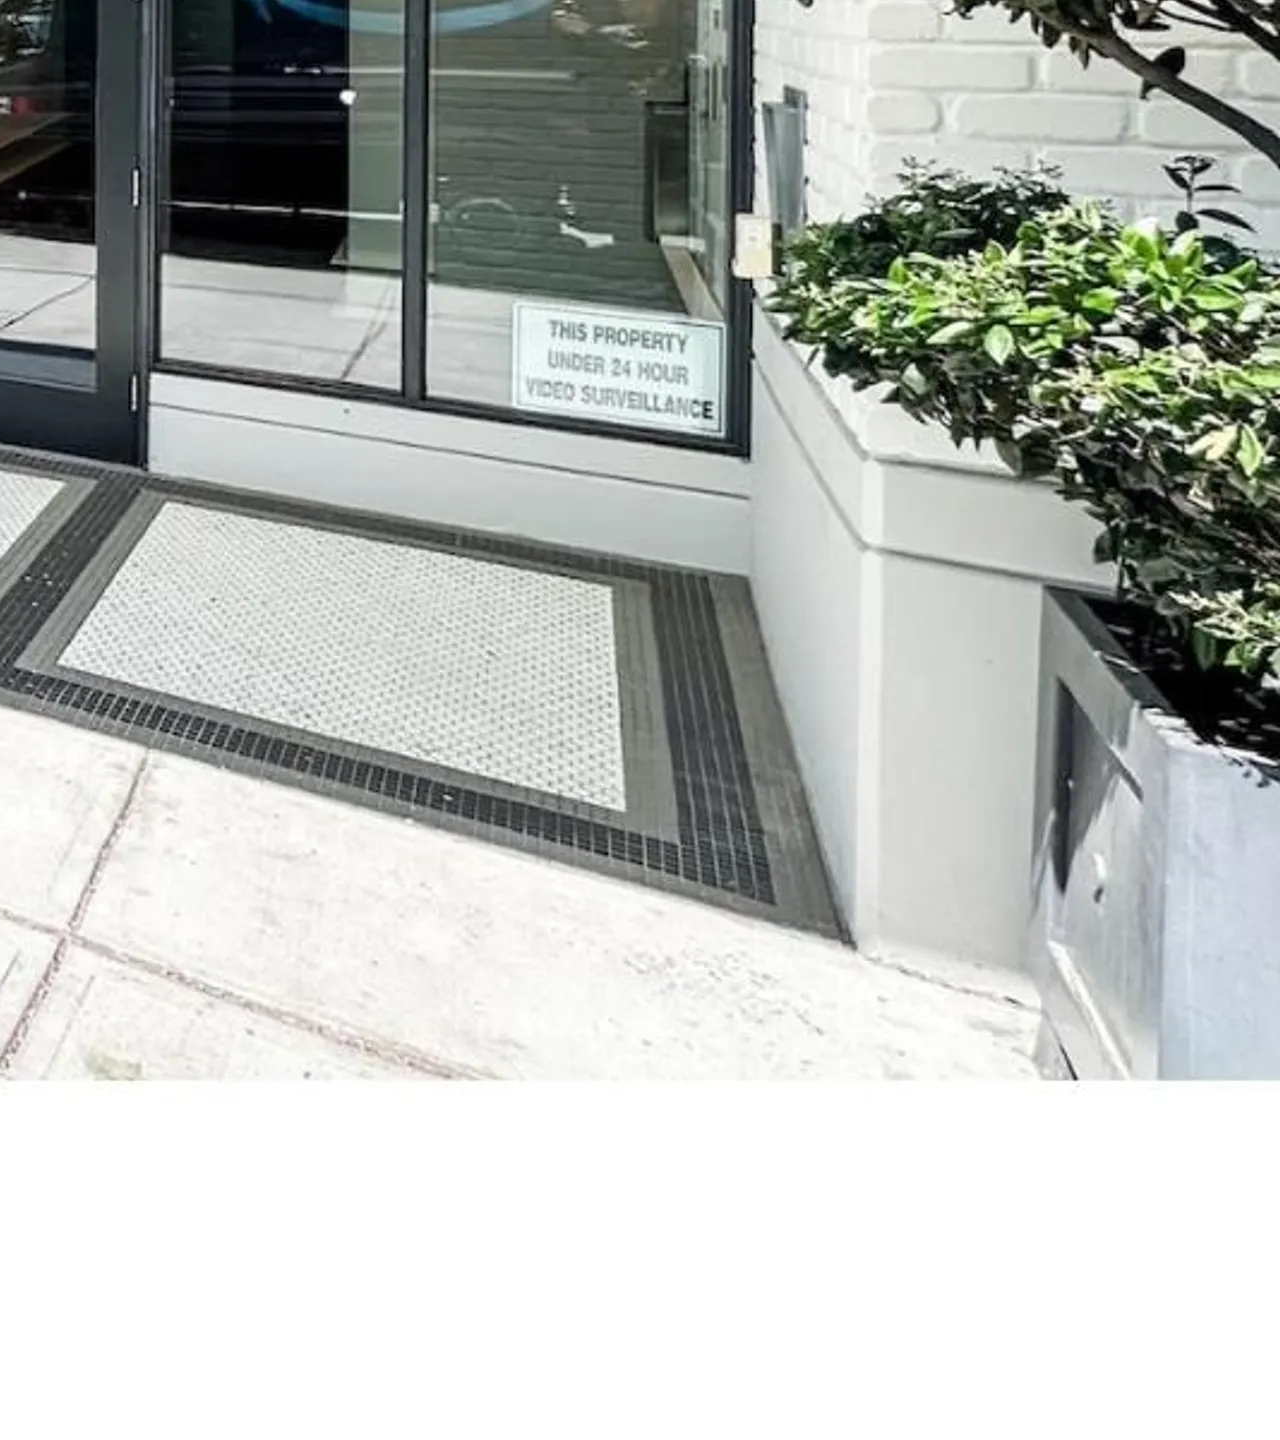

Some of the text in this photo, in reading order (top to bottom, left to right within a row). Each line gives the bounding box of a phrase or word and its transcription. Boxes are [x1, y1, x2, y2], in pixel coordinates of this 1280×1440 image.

[548, 319, 690, 354] THIS PROPERTY
[547, 349, 690, 385] UNDER 24 HOUR
[525, 376, 715, 421] VIDEO SURVEILLANCE
